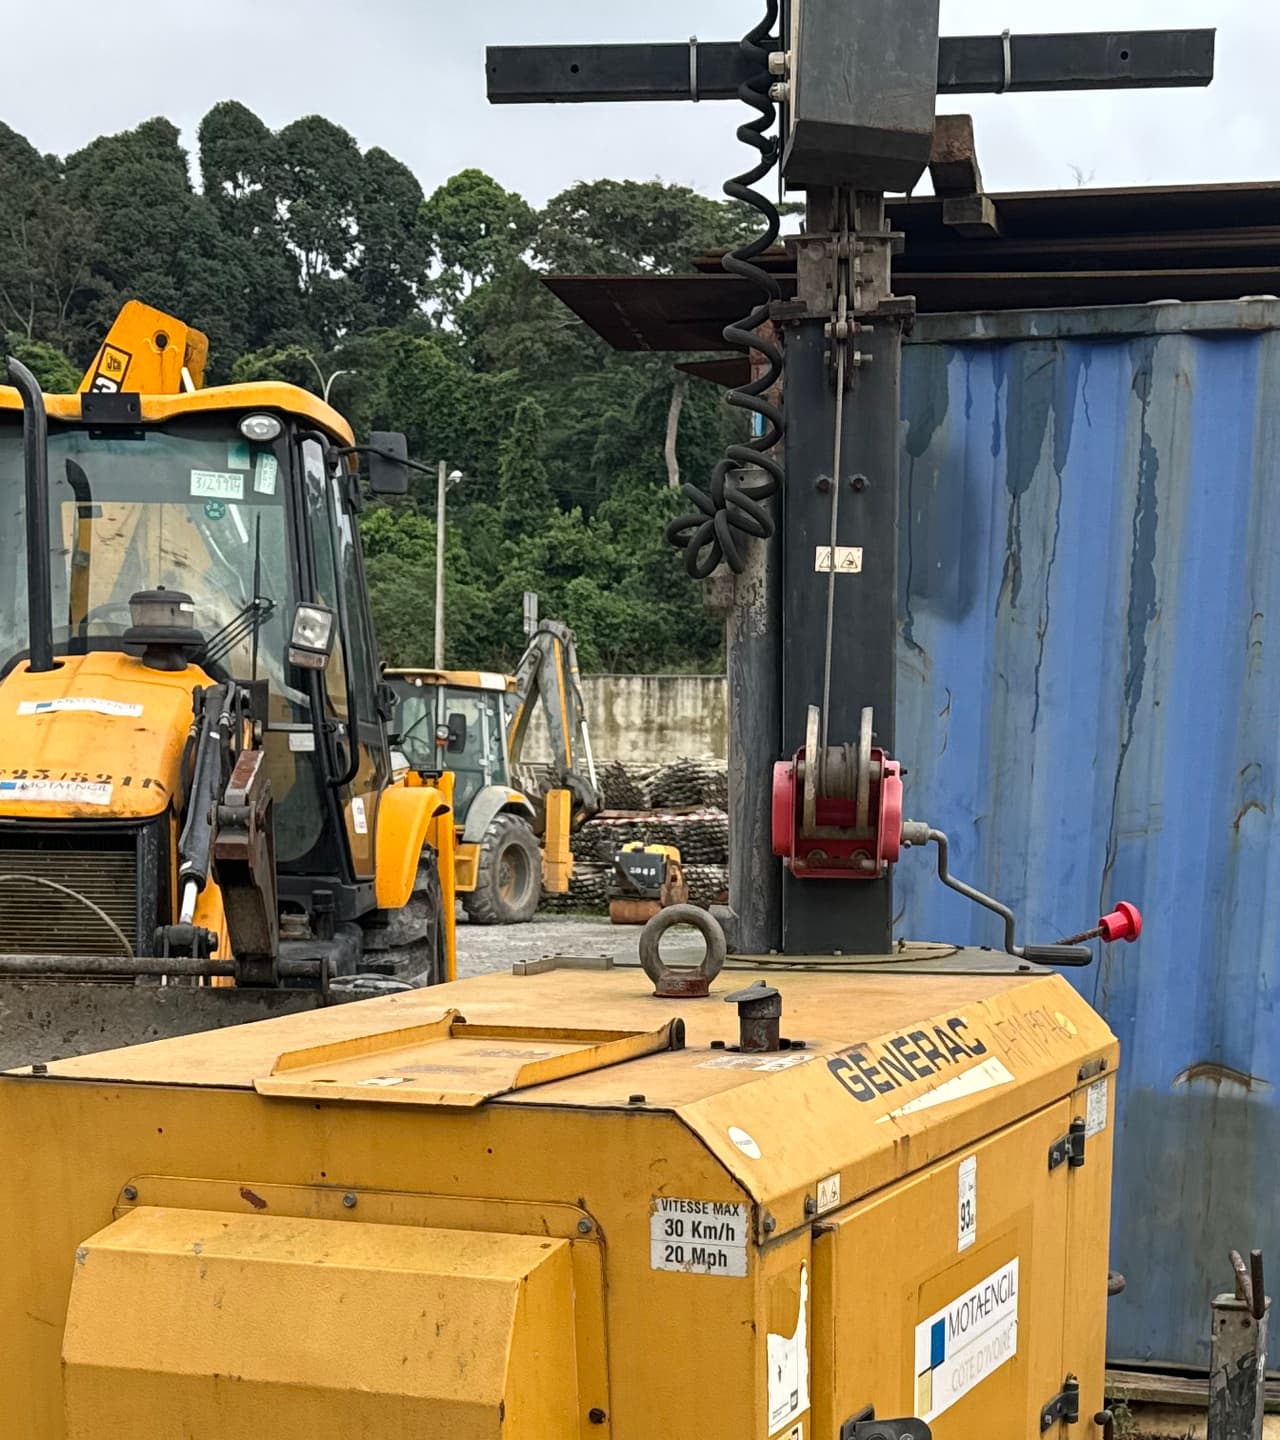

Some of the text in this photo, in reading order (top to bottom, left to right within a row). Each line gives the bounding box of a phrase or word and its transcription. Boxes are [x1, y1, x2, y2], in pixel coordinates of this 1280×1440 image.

[827, 1017, 988, 1102] GENERAC
[661, 1198, 740, 1217] VITESSE MAX
[960, 1199, 971, 1232] 93
[664, 1218, 735, 1241] 30 Km/h
[664, 1245, 728, 1270] 20 Mph
